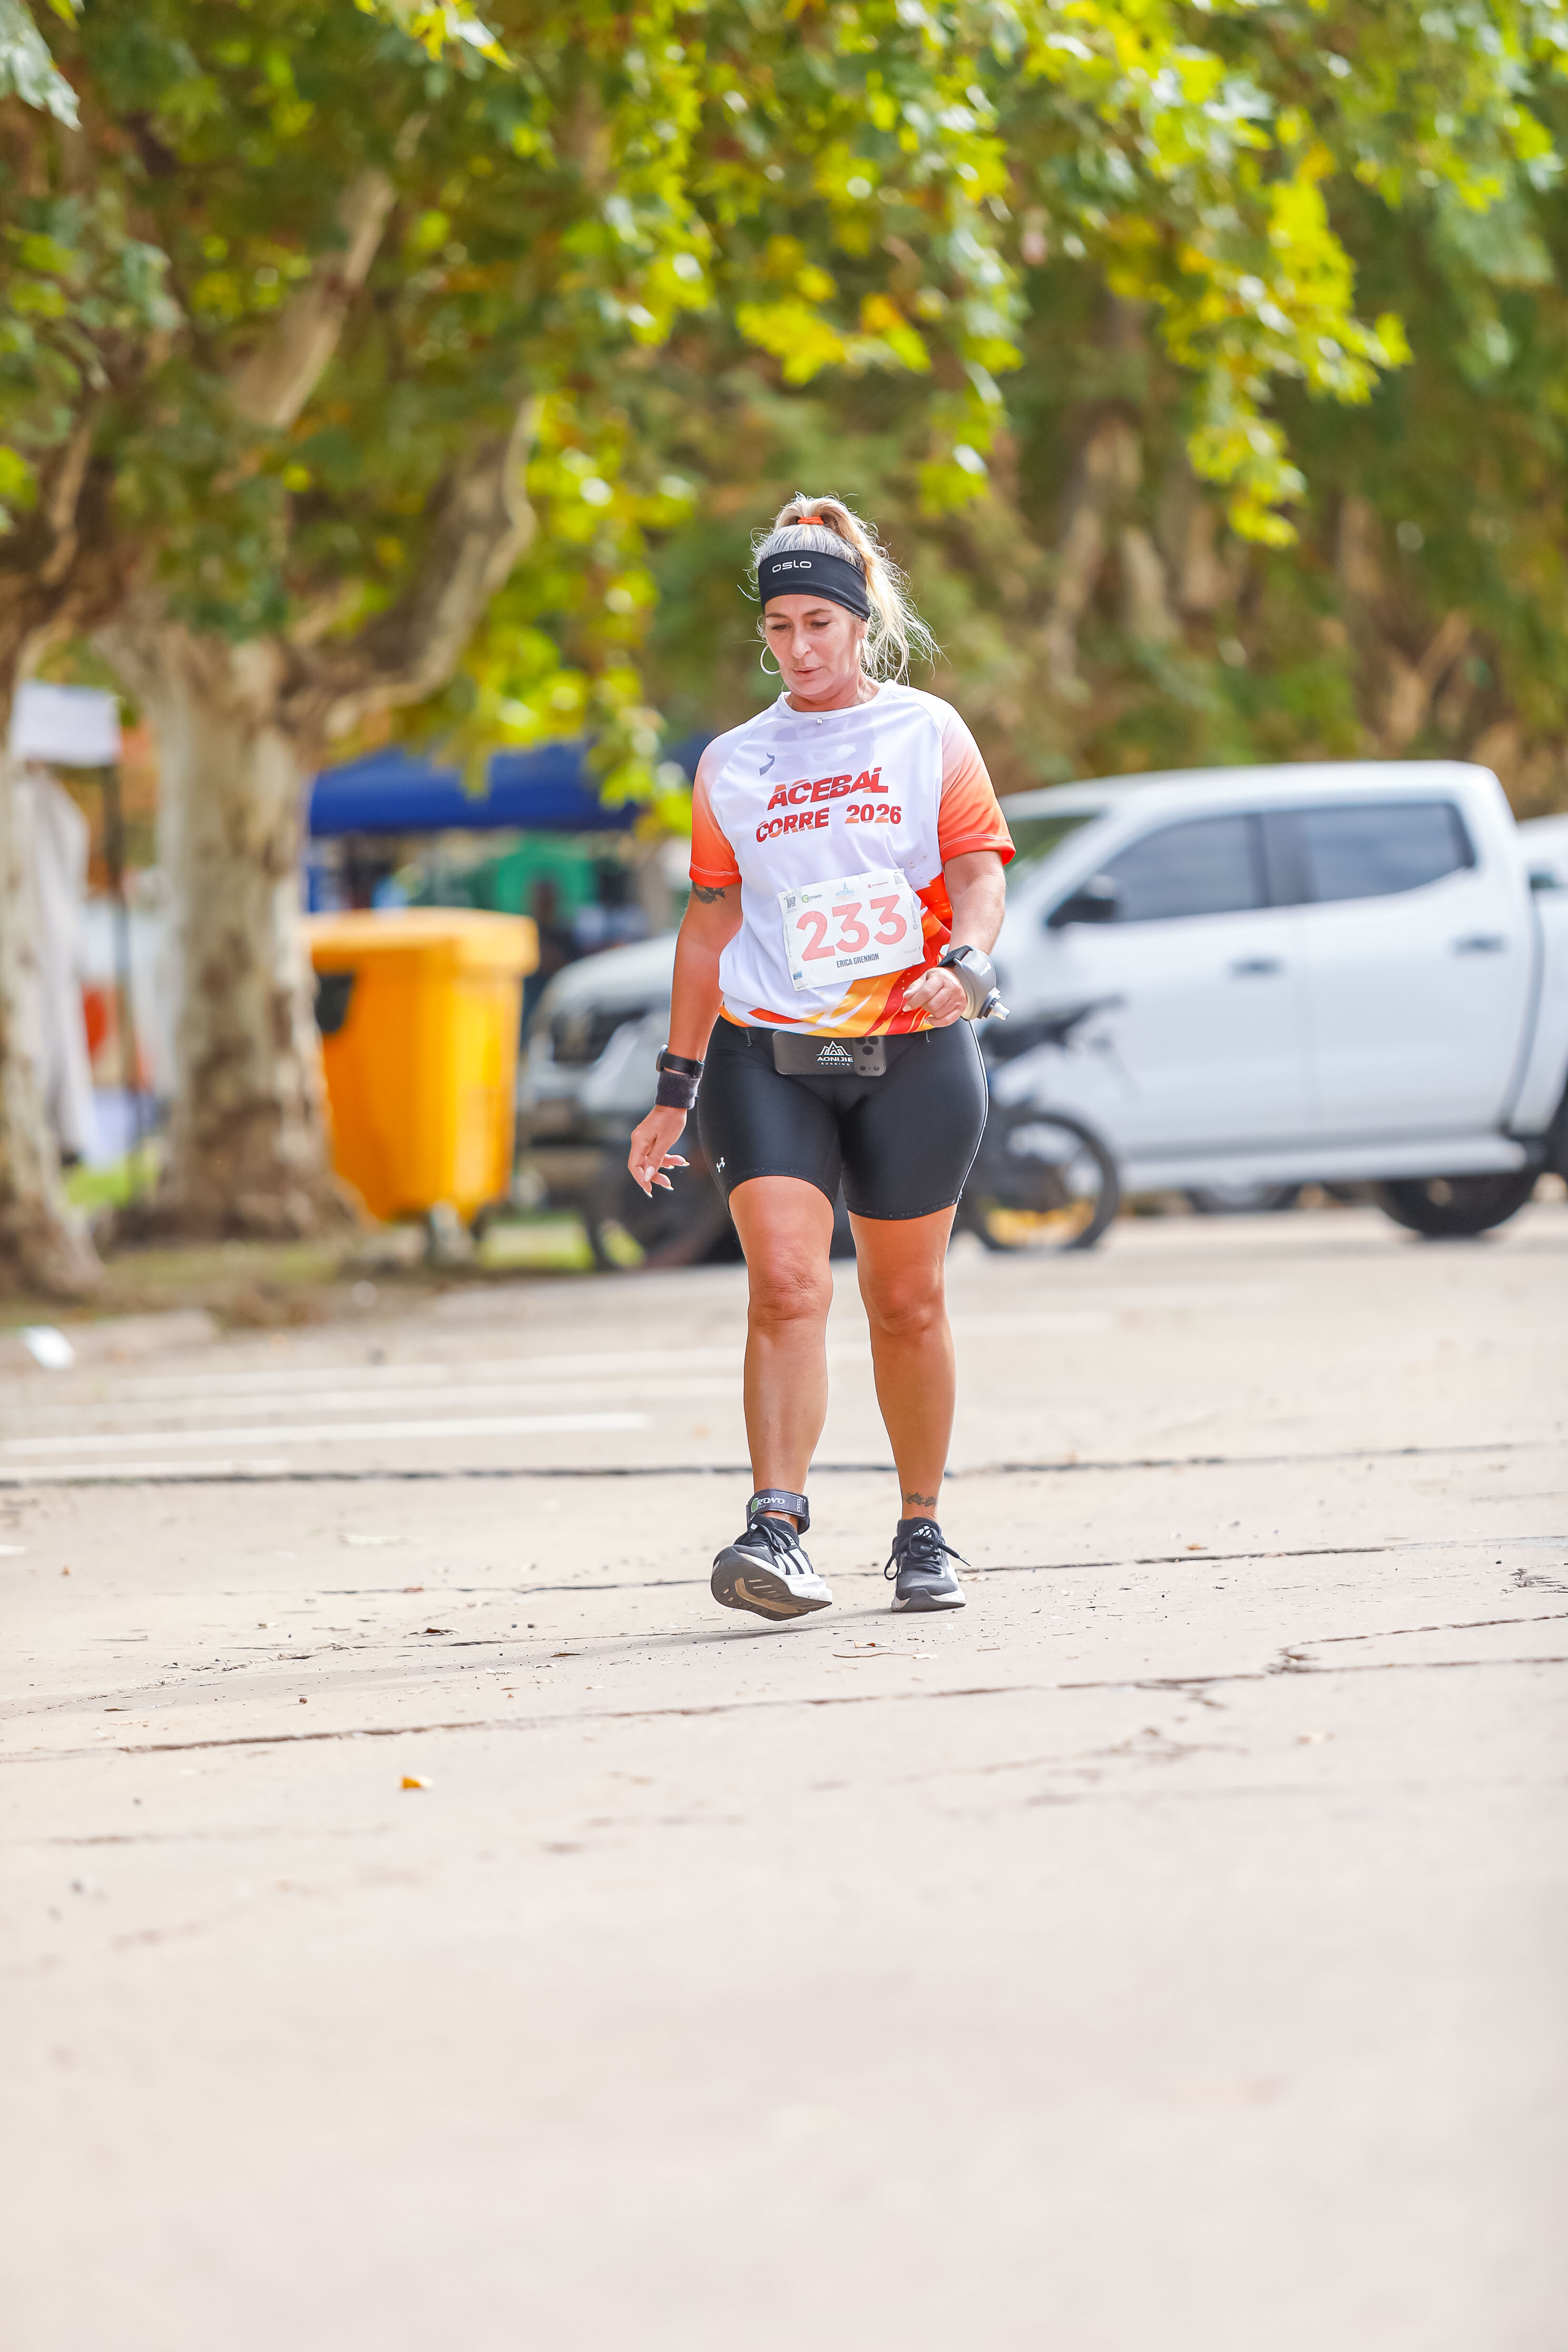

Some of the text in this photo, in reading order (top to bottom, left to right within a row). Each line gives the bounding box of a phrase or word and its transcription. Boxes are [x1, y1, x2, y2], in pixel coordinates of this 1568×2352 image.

[772, 560, 812, 573] OSLO
[767, 767, 889, 811] ACEBAL
[756, 803, 902, 842] CORRE 2026
[796, 894, 907, 962] 233
[836, 953, 879, 968] ERICA GRENNON
